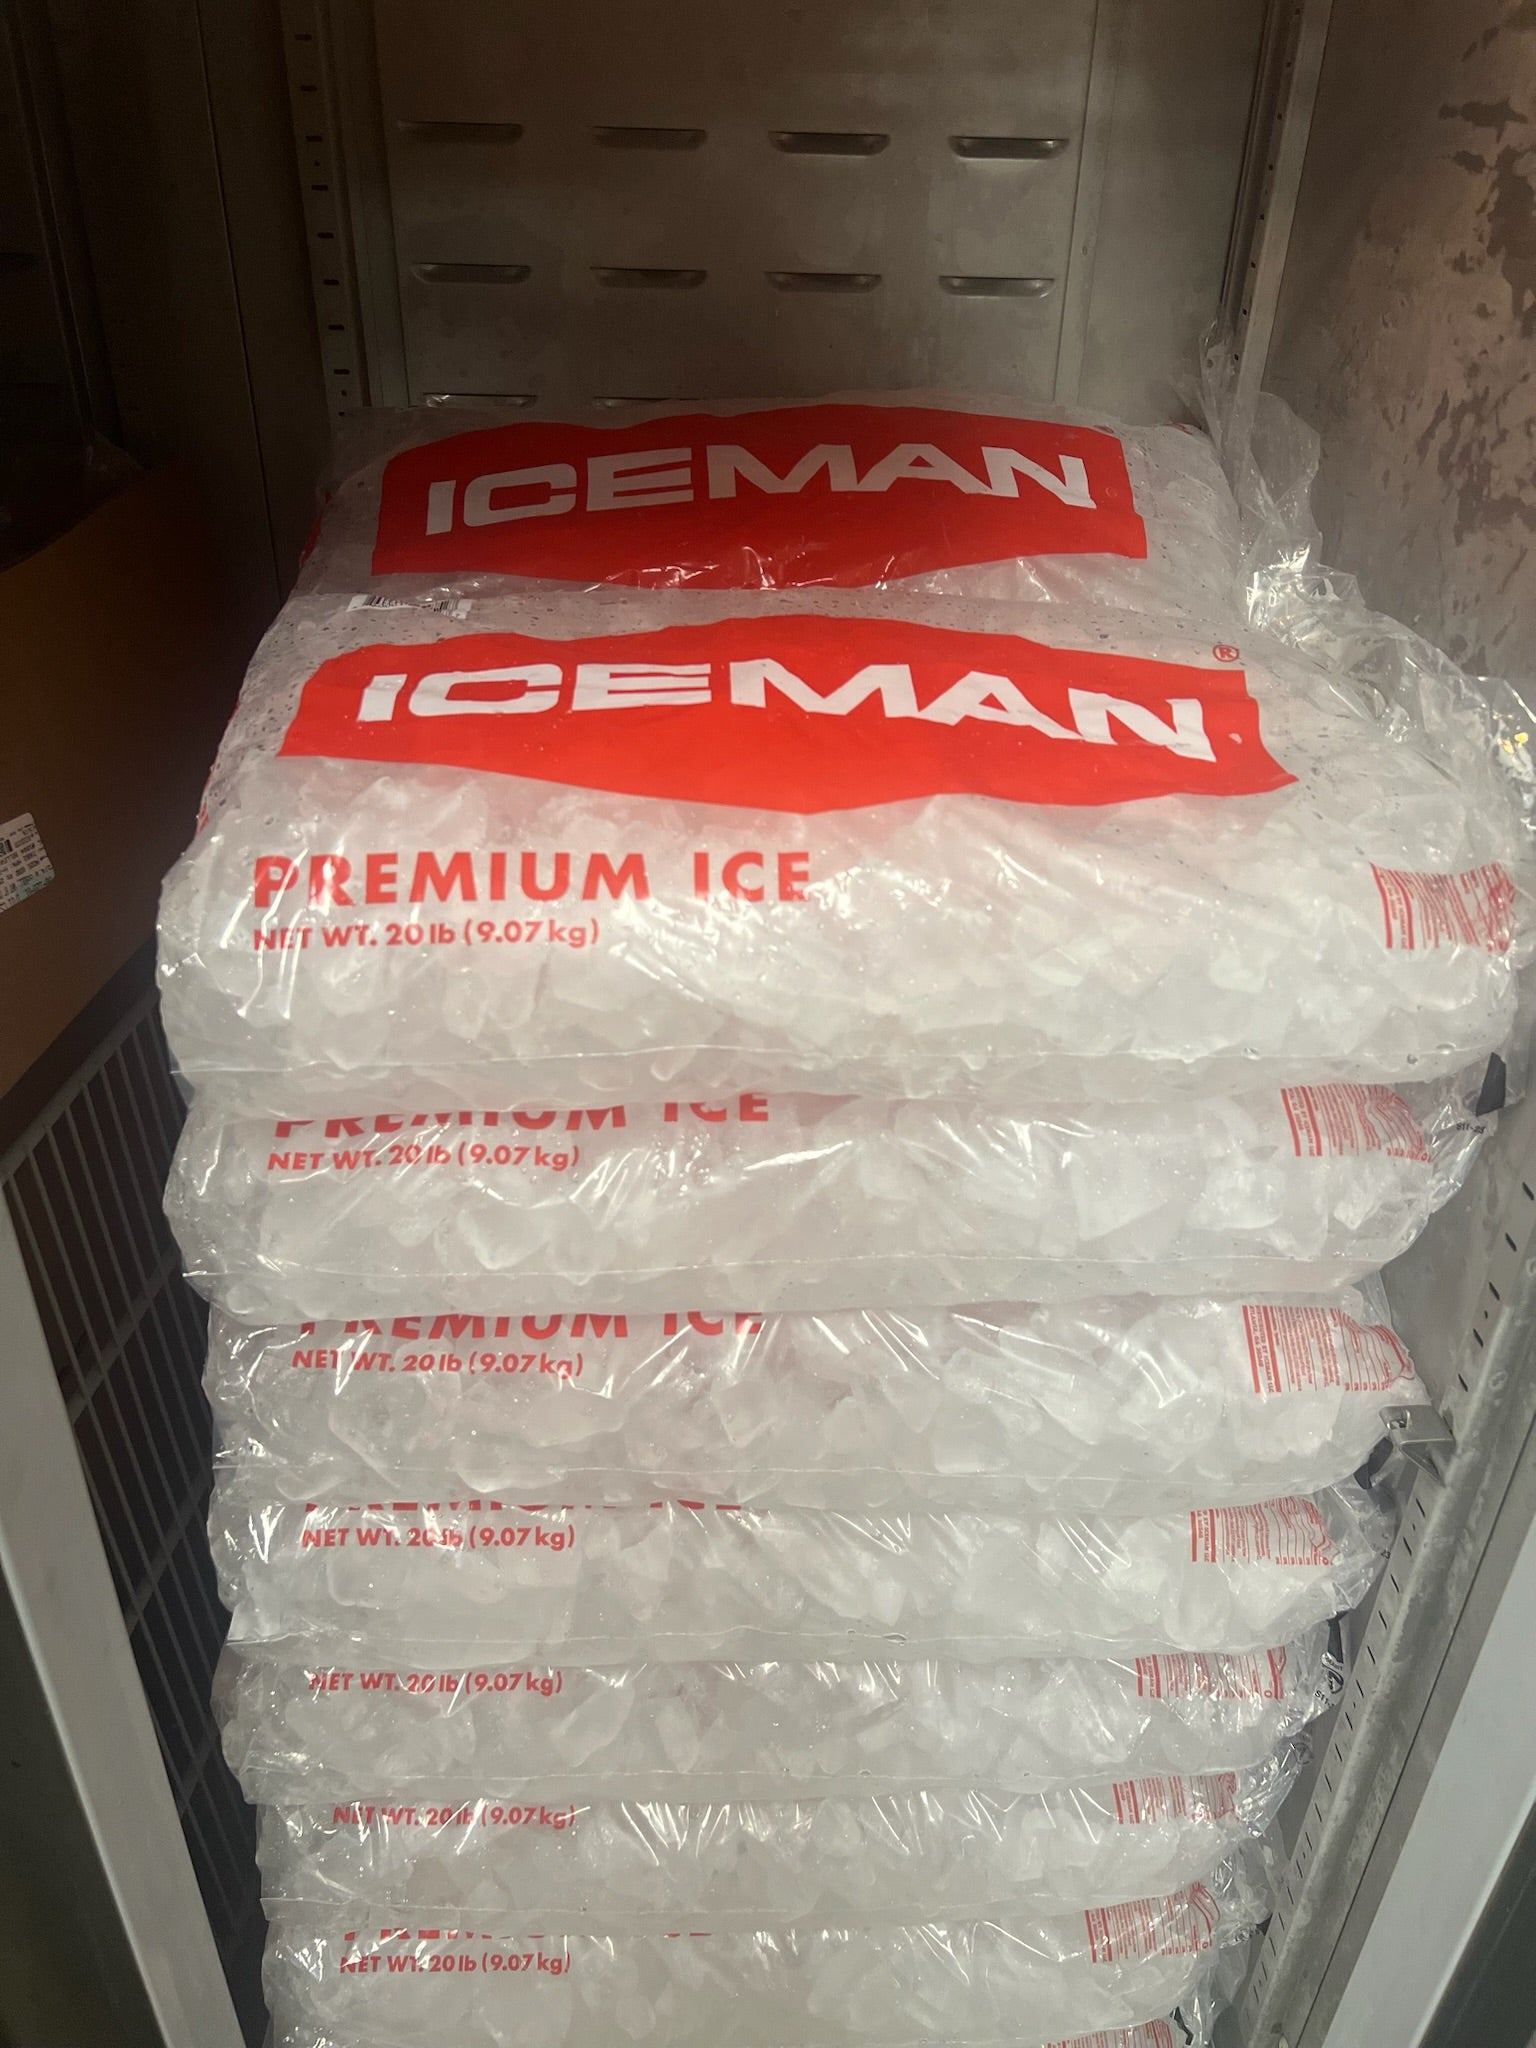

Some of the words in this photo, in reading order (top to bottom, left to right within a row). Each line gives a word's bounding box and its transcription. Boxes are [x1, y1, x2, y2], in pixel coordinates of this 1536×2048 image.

[426, 443, 1097, 535] ICEMAN
[357, 658, 1217, 762] ICEMAN
[254, 851, 649, 907] PREMIUM
[694, 851, 809, 902] ICE
[253, 928, 311, 950] NET
[322, 925, 376, 947] WT.
[463, 920, 541, 944] (9.07
[548, 919, 598, 949] kg)
[268, 1153, 322, 1170] NET
[333, 1150, 382, 1169] WT.
[458, 1143, 529, 1165] (9.07
[534, 1146, 579, 1171] kg)
[292, 1349, 339, 1369] NET
[351, 1352, 395, 1372] WT.
[469, 1353, 536, 1373] (9.07
[539, 1353, 582, 1379] kg)
[302, 1528, 348, 1547] NET
[356, 1528, 399, 1547] WT.
[470, 1527, 531, 1548] (9.07
[535, 1527, 574, 1551] kg)
[309, 1673, 352, 1691] NET
[360, 1673, 399, 1691] WT.
[466, 1673, 522, 1693] (9.07
[526, 1672, 562, 1696] kg)
[333, 1807, 374, 1824] NET
[381, 1807, 419, 1825] WT.
[482, 1807, 537, 1824] (9.07
[540, 1807, 575, 1830] kg)
[340, 1956, 380, 1973] NET
[387, 1956, 423, 1973] WT.
[481, 1954, 533, 1971] (9.07
[537, 1953, 570, 1975] kg)
